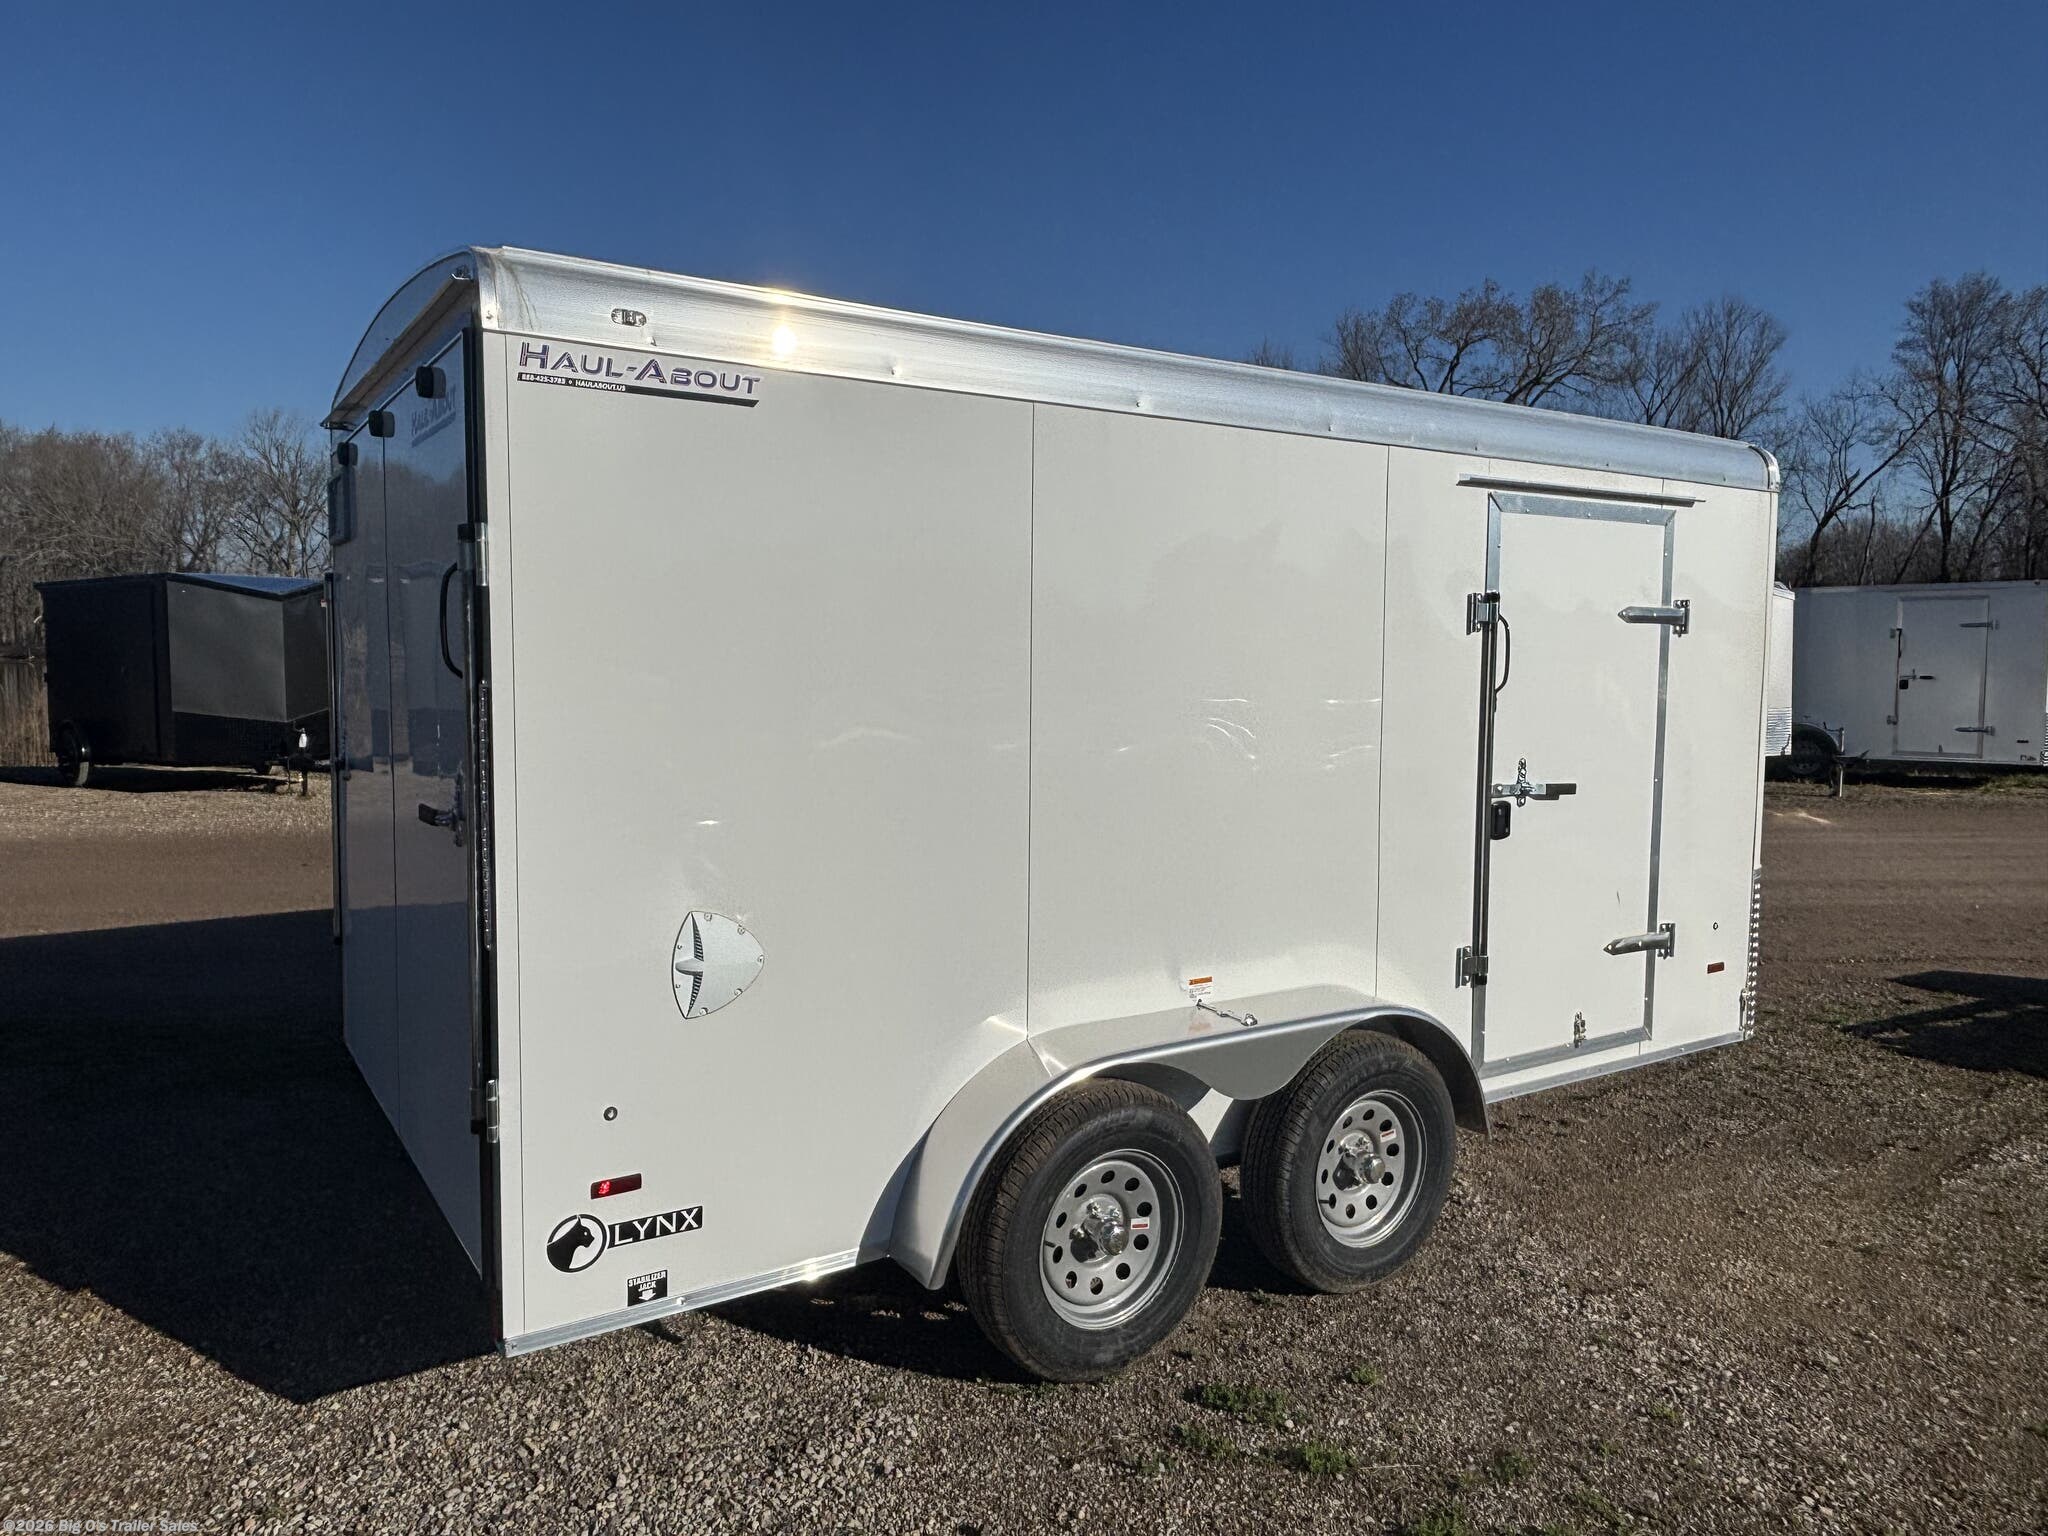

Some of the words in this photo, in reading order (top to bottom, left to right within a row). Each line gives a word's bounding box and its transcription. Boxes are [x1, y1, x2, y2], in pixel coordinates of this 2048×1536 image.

[614, 1207, 699, 1245] LYNX
[628, 1271, 666, 1287] STABILIZER
[638, 1280, 656, 1292] JACK
